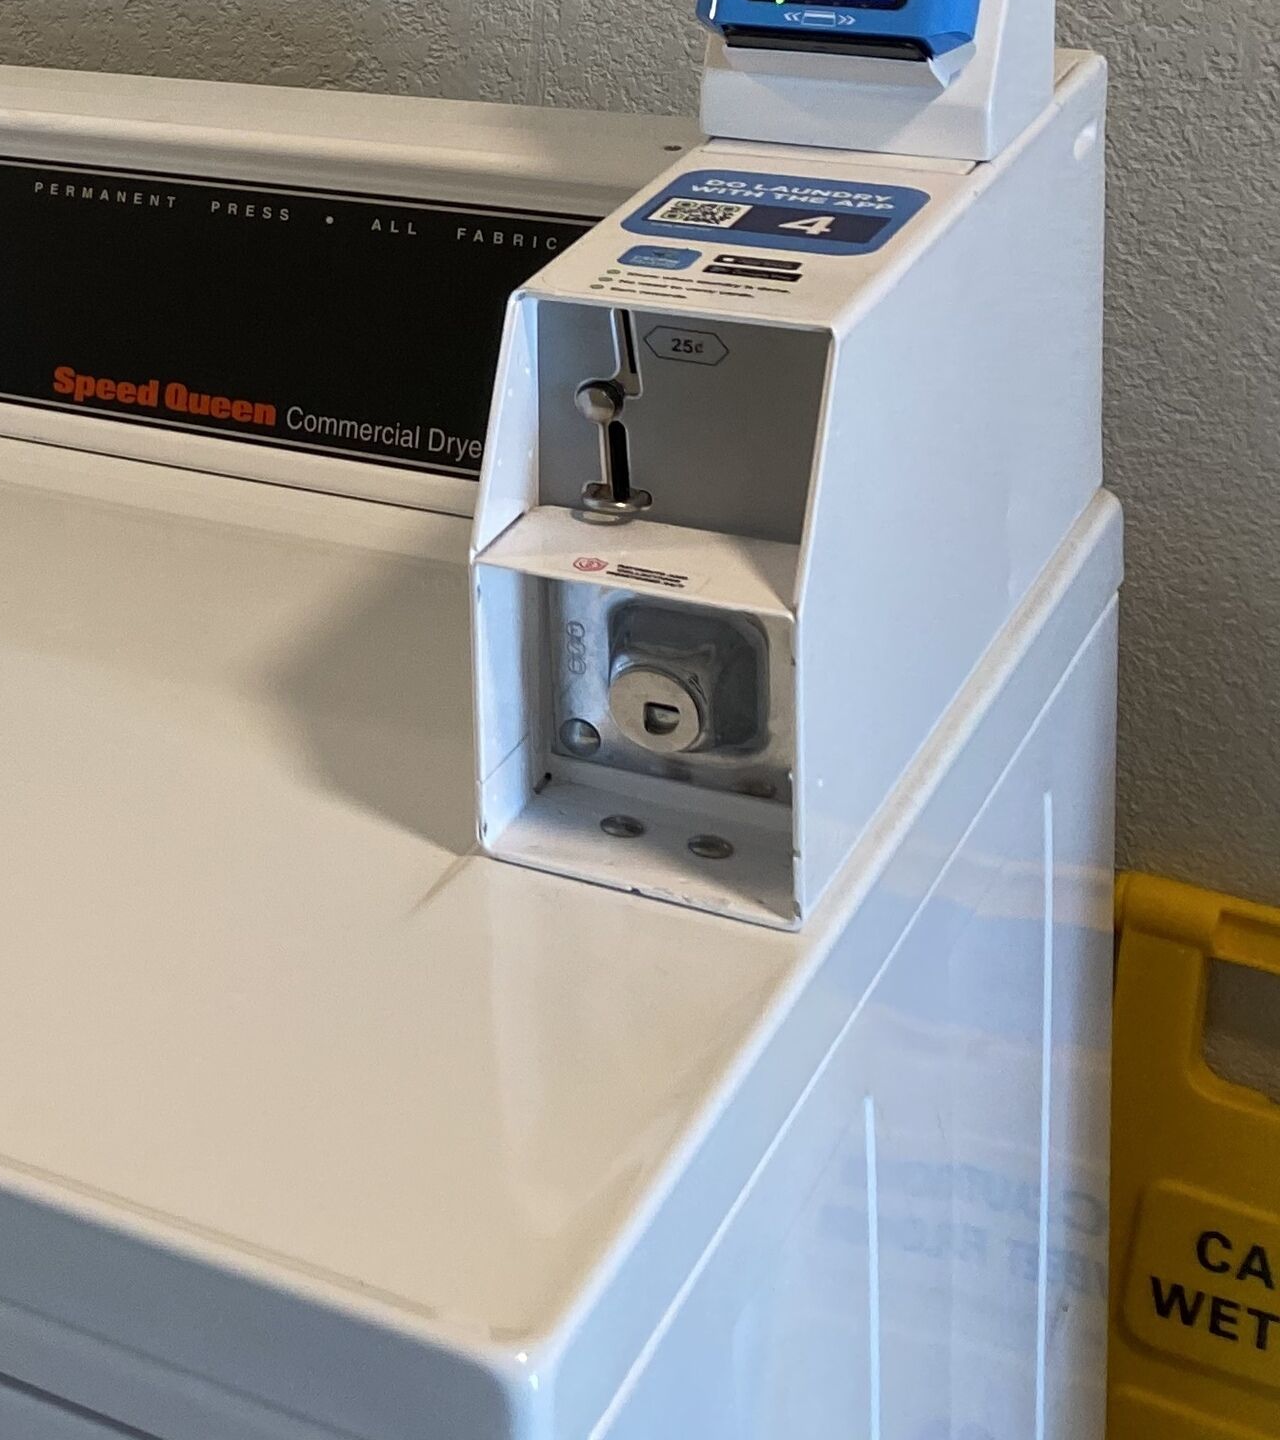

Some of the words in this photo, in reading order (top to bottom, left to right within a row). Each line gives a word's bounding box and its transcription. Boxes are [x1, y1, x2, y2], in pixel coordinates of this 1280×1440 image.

[34, 181, 178, 208] PERMANENT
[210, 200, 291, 222] PRESS
[370, 218, 418, 236] ALL
[457, 227, 558, 250] FABRIC
[690, 184, 764, 198] WITH
[772, 192, 828, 205] THE
[832, 200, 896, 210] APP
[706, 179, 748, 190] DO
[755, 183, 894, 202] LAUNDRY
[778, 216, 836, 236] 4
[53, 365, 159, 407] Speed
[164, 382, 277, 426] Queen
[286, 406, 420, 450] Commercial
[428, 427, 483, 462] Drye
[1196, 1230, 1275, 1291] CA
[1149, 1275, 1280, 1351] WET
